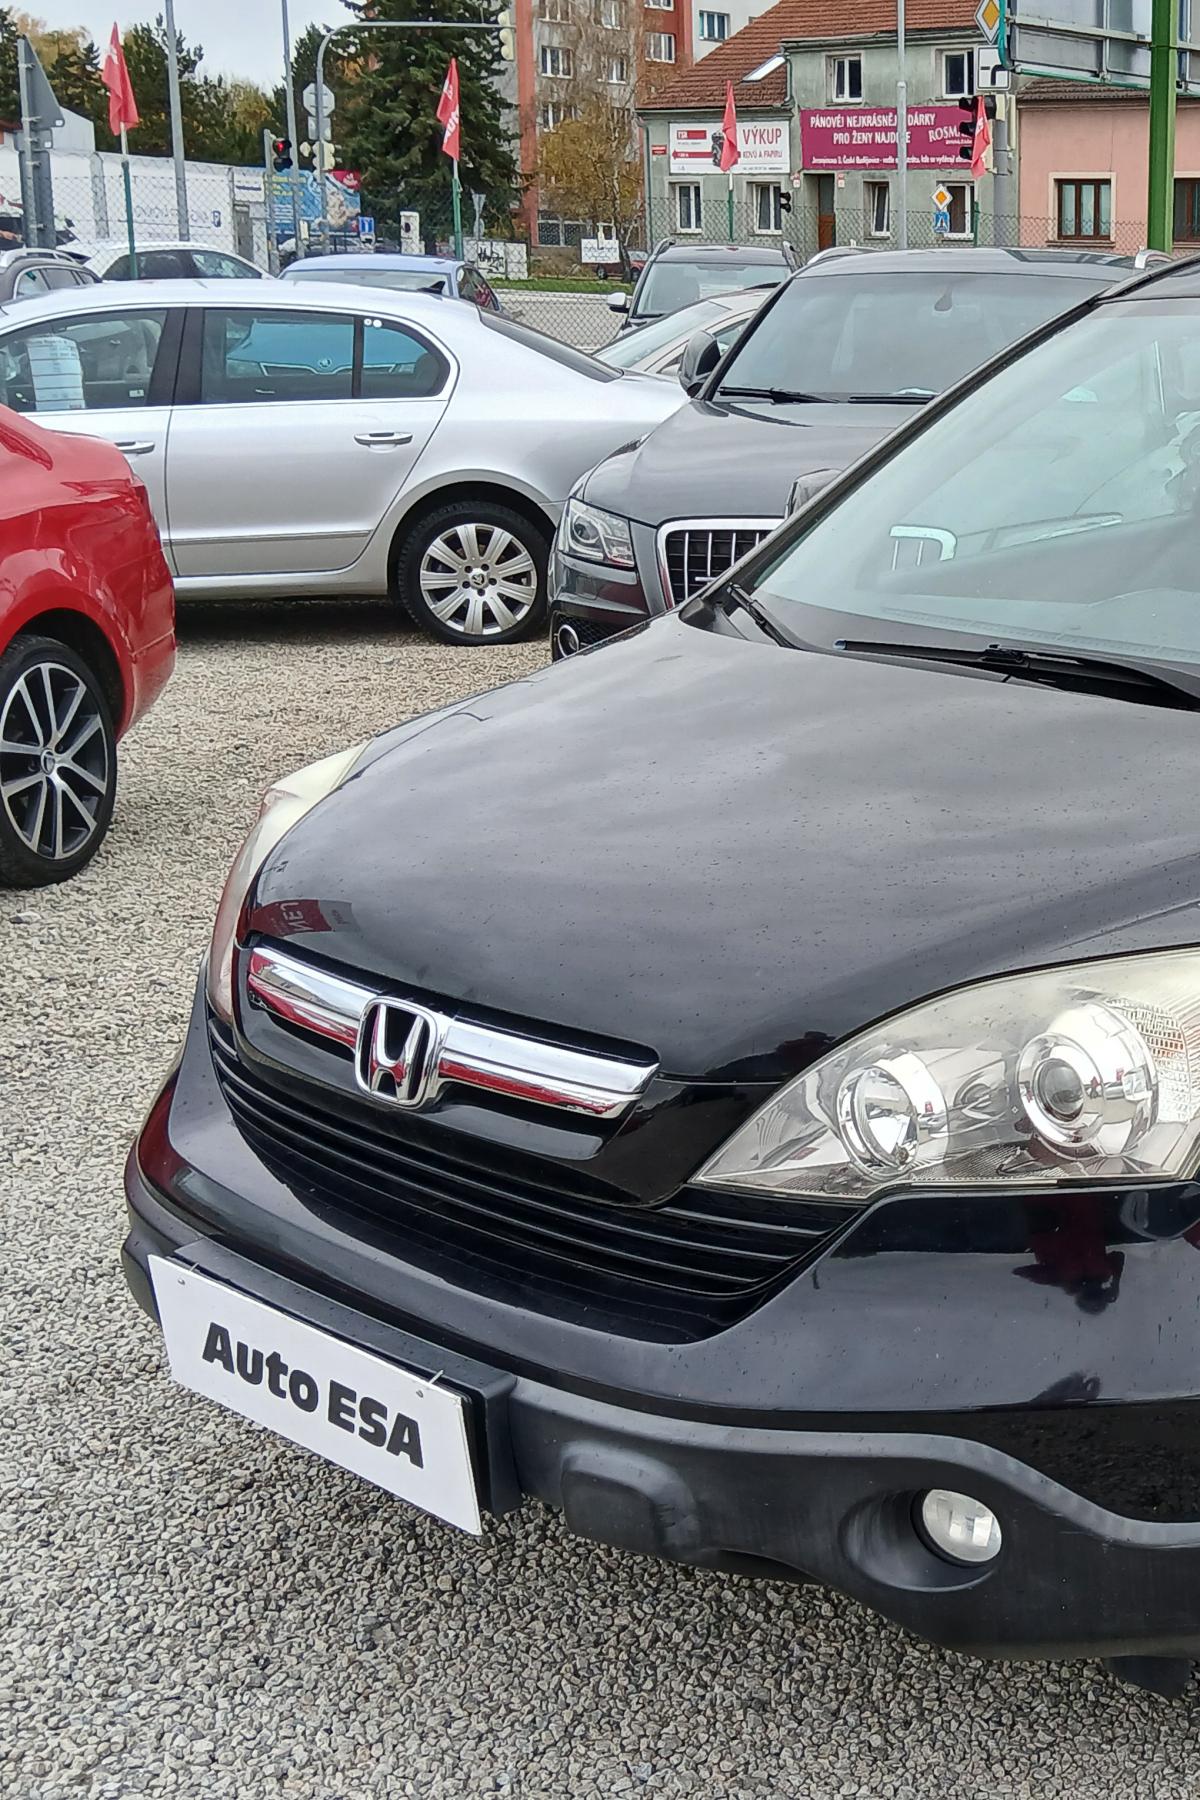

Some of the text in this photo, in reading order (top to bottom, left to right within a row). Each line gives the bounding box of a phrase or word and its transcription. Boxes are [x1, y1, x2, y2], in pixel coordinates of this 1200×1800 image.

[846, 111, 898, 127] NEJKRÁSNĚJ
[907, 111, 936, 126] DÁRKY
[742, 125, 782, 145] VÝKUP
[833, 132, 850, 145] PRO
[851, 130, 873, 144] ŽENY
[201, 1321, 425, 1470] Auto ESA
